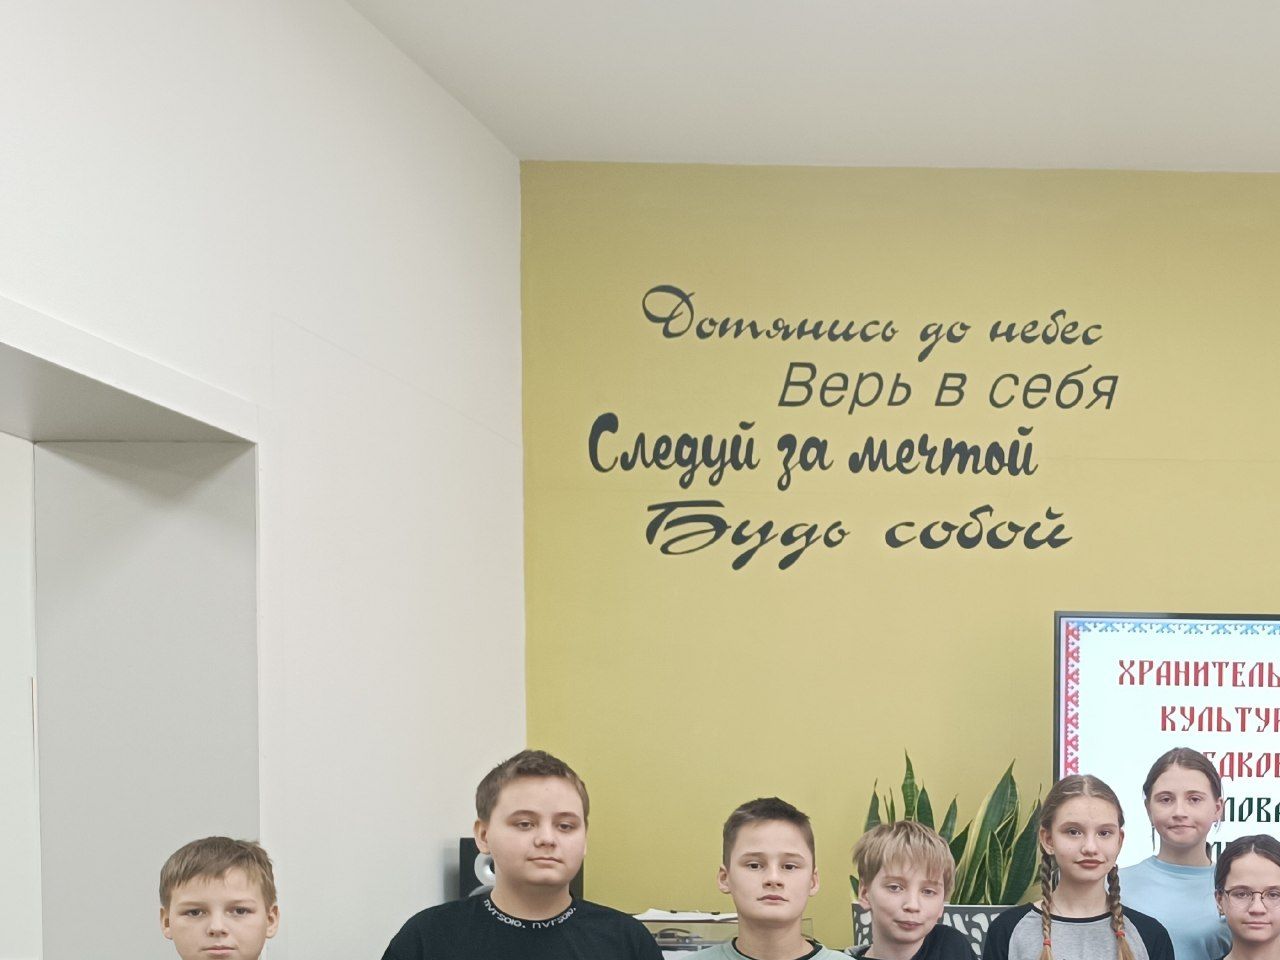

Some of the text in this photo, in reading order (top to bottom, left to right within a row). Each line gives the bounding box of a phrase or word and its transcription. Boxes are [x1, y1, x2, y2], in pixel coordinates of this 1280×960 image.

[642, 284, 1103, 362] Дотянись до небес
[778, 361, 1119, 415] Верь в себя
[588, 412, 1039, 491] Следуй за мечтой
[645, 500, 1073, 571] Будь собой
